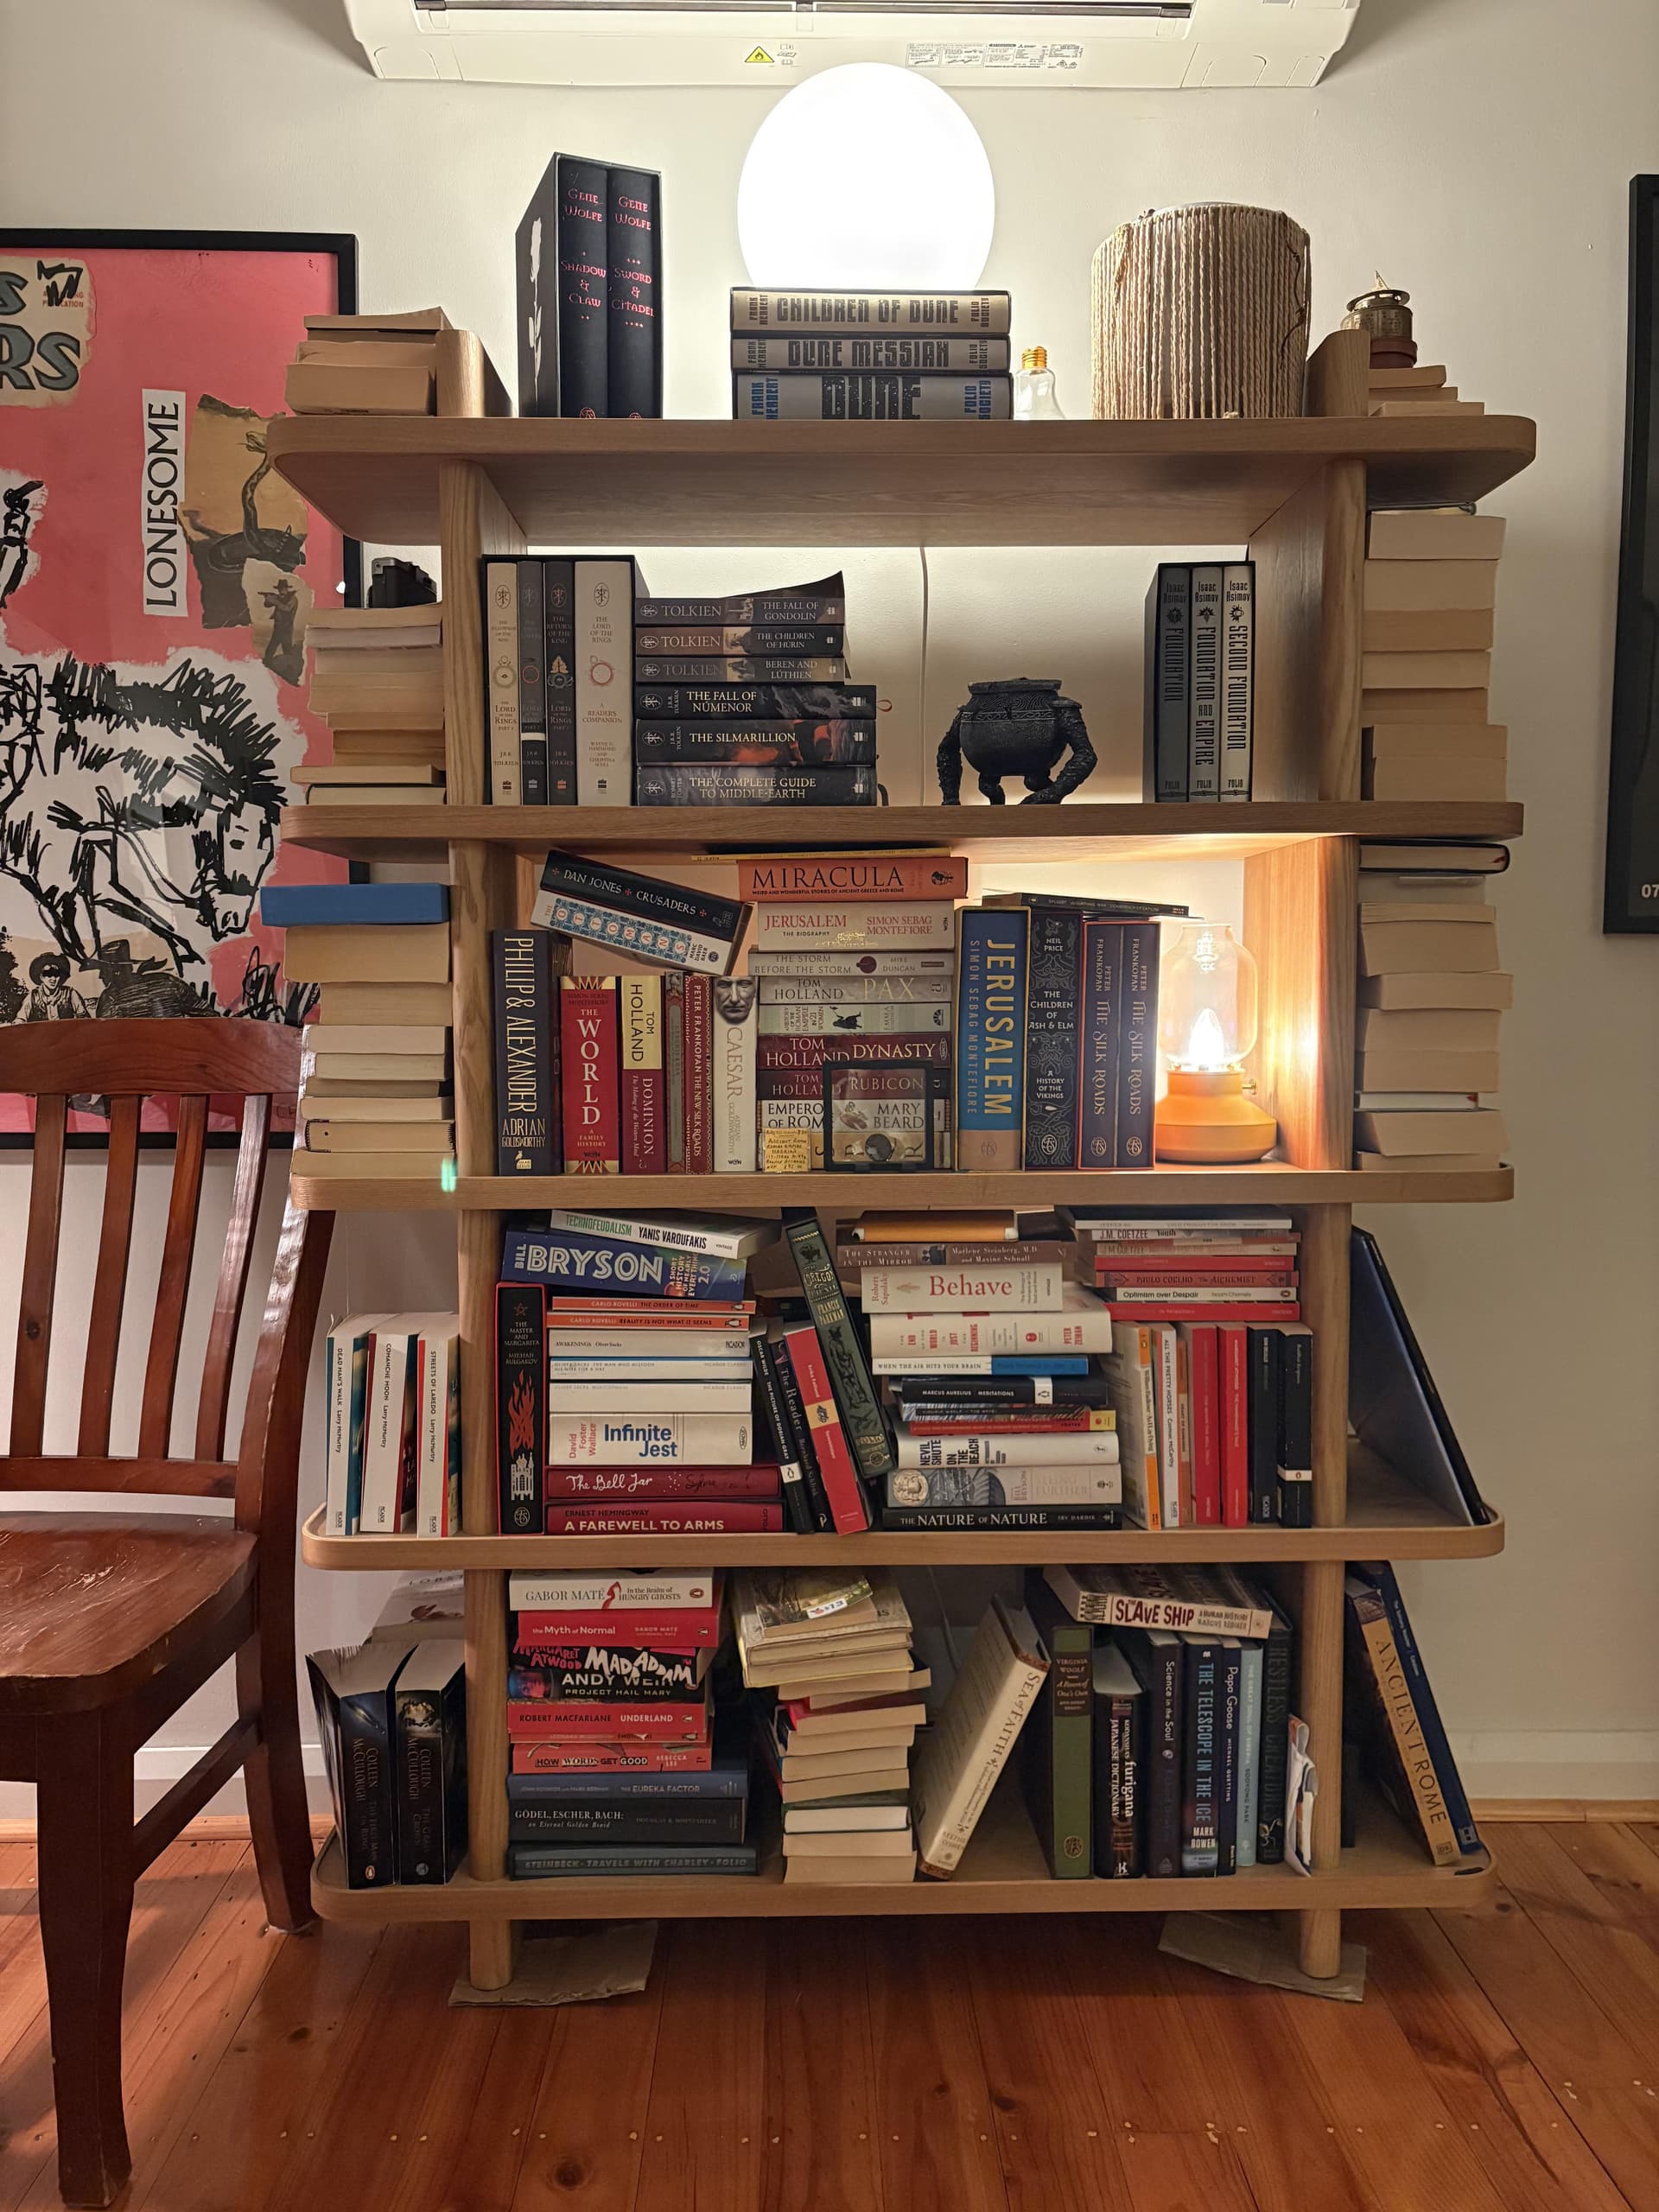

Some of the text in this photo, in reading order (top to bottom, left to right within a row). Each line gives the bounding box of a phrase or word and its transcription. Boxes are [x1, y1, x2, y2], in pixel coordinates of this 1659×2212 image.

[564, 206, 602, 222] WOLFE
[560, 260, 607, 278] SHADOW
[614, 266, 652, 284] SWORD
[569, 293, 601, 308] CLAW
[611, 299, 655, 318] CITADEL
[778, 297, 959, 324] CHILDREN OF DUNE
[788, 340, 950, 367] DUNE MESSIAH
[822, 376, 921, 419] DUNE
[147, 403, 178, 607] LONESOME
[662, 604, 721, 617] TOLKIEN
[762, 601, 780, 611] THE
[783, 601, 805, 611] FALL
[765, 611, 817, 621] GONDOLIN
[662, 635, 721, 648] TOLKIEN
[687, 691, 757, 702] THE FALL OF
[1196, 627, 1216, 766] FOUNDATION AND EMPIRE
[1227, 626, 1248, 750] SECOND FOUNDATION
[690, 732, 796, 743] THE SILMARILLION
[690, 777, 817, 788] THE COMPLETE GUIDE
[700, 788, 806, 799] TO MIDDLE-EARTH
[753, 866, 904, 889] MIRACULA
[563, 869, 696, 915] DAN JONES CRUSADERS
[765, 915, 847, 931] JERUSALEM
[774, 979, 843, 1000] TOM HOLLAND
[863, 977, 915, 1000] PAX
[1030, 1001, 1073, 1009] CHILDREN
[505, 938, 537, 1113] PHILIP & ALEXANDER
[630, 984, 644, 1062] HOLLAND
[967, 940, 980, 1114] SIMON SEBAG MONTEFIORE
[984, 939, 1015, 1115] JERUSALEM
[1028, 1021, 1046, 1030] ASH
[1057, 1021, 1074, 1030] ELM
[694, 1015, 702, 1073] FRANKOPAN
[790, 1039, 824, 1050] TOM
[854, 1043, 936, 1058] DYNASTY
[577, 1020, 601, 1125] WORLD
[727, 1027, 743, 1100] CAESAR
[850, 1077, 924, 1090] RUBICON
[643, 1077, 654, 1154] DOMINION
[878, 1103, 920, 1116] MARY
[501, 1119, 546, 1147] ADRIAN GOLDSWORTHY
[874, 1116, 925, 1128] BEARD
[693, 1128, 702, 1156] ROADS
[566, 1215, 707, 1249] TECHNOFEUDALISM YANIS VAROUFAKIS
[1100, 1230, 1148, 1239] J.M. COETZEE
[515, 1244, 663, 1284] BILL BRYSON
[930, 1274, 1013, 1296] Behave
[604, 1423, 677, 1458] Infinite Jest
[947, 1453, 957, 1465] ON
[958, 1450, 968, 1465] THE
[969, 1439, 979, 1465] BEACH
[920, 1440, 941, 1465] NEVIL SHUTE
[566, 1473, 652, 1492] The Bell Jar
[564, 1520, 724, 1531] A FAREWELL TO ARMS
[918, 1514, 975, 1526] NATURE
[990, 1513, 1047, 1525] NATURE
[525, 1591, 568, 1601] GABOR
[1116, 1599, 1160, 1624] SLAVE
[1163, 1605, 1195, 1626] SHIP
[562, 1673, 615, 1685] ANDY
[1018, 1672, 1040, 1700] SEA
[1225, 1667, 1238, 1730] Papa Goose
[992, 1711, 1024, 1757] FAITH
[1196, 1663, 1214, 1821] THE TELESCOPE IN THE ICE
[1376, 1640, 1427, 1753] ANCIENT
[1414, 1759, 1447, 1823] ROME
[562, 1758, 598, 1766] WORDS
[1109, 1719, 1120, 1818] JAPANESE DICTIONARY
[1122, 1761, 1137, 1818] furigana
